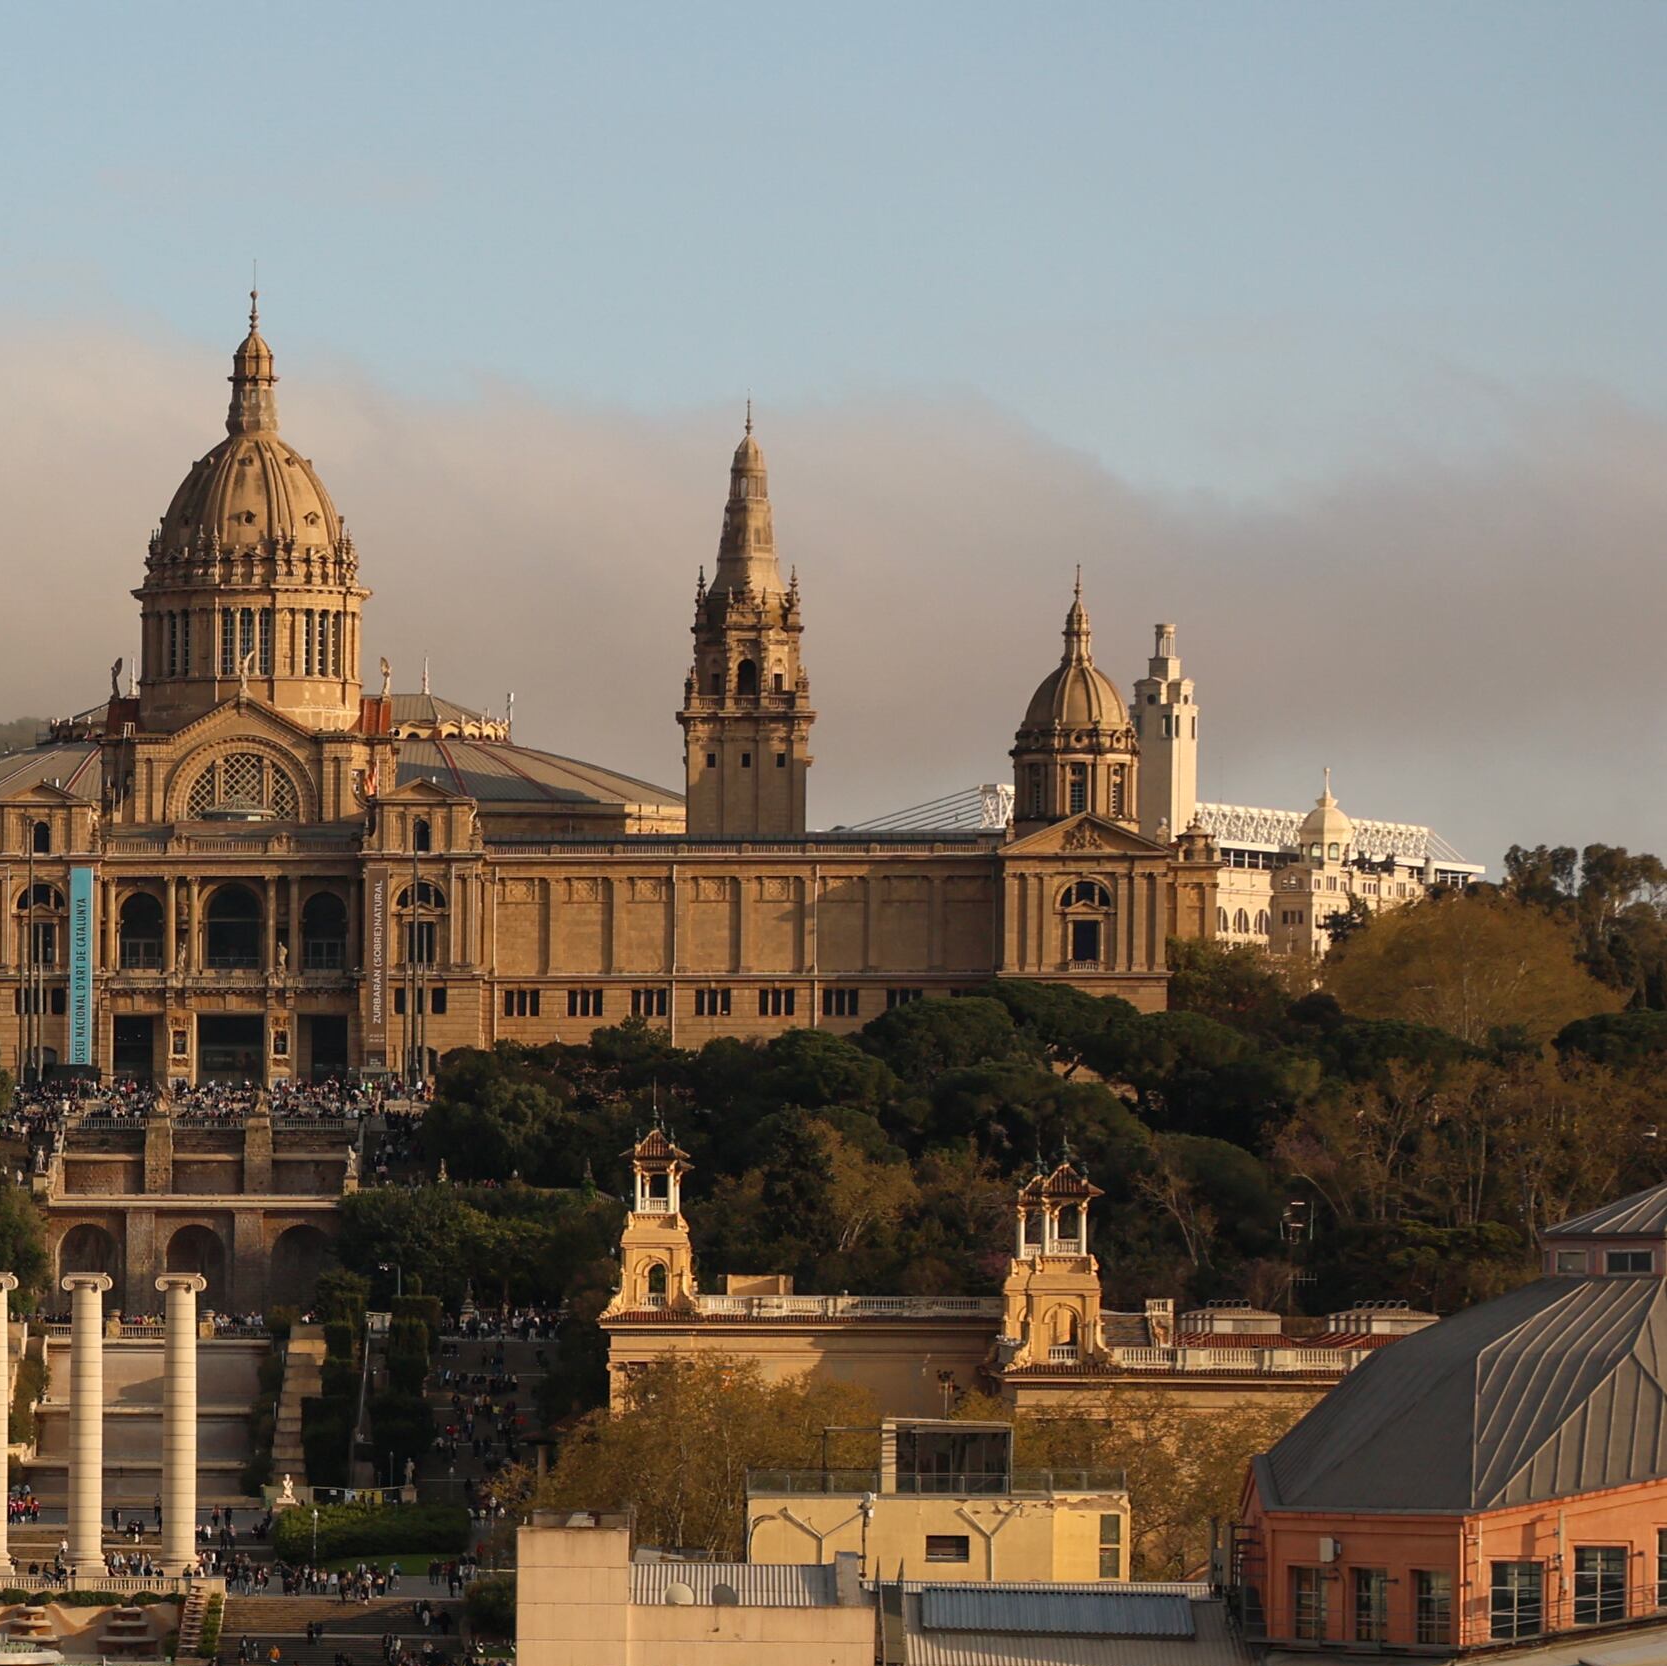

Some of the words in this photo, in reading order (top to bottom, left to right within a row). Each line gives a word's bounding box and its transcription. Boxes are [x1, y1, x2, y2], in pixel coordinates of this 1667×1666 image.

[76, 898, 87, 948] CATALUNYA
[372, 880, 383, 968] (SOBRE)NATURAL
[75, 950, 86, 962] DE
[75, 965, 86, 991] D'ART
[372, 969, 382, 1024] ZURBARÁN
[74, 994, 86, 1037] NACIONAL
[74, 1040, 85, 1063] USEU
